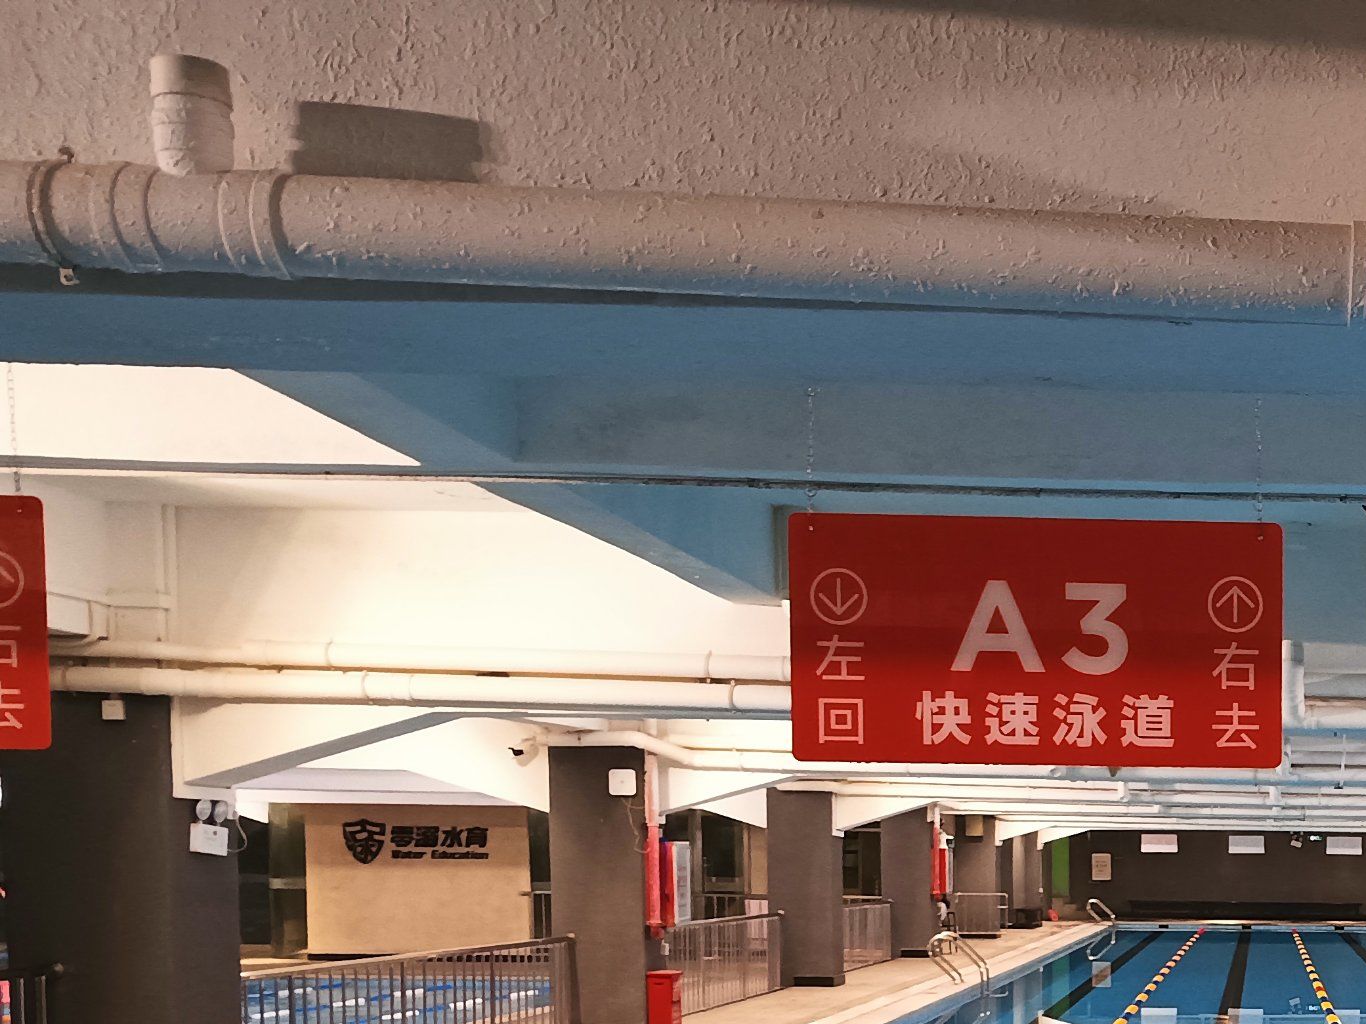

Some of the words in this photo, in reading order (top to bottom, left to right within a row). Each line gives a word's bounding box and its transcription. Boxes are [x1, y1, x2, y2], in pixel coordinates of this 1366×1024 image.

[950, 579, 1129, 675] A3
[815, 634, 866, 745] 左回
[915, 690, 1176, 748] 快速泳道
[1210, 642, 1261, 751] 右去
